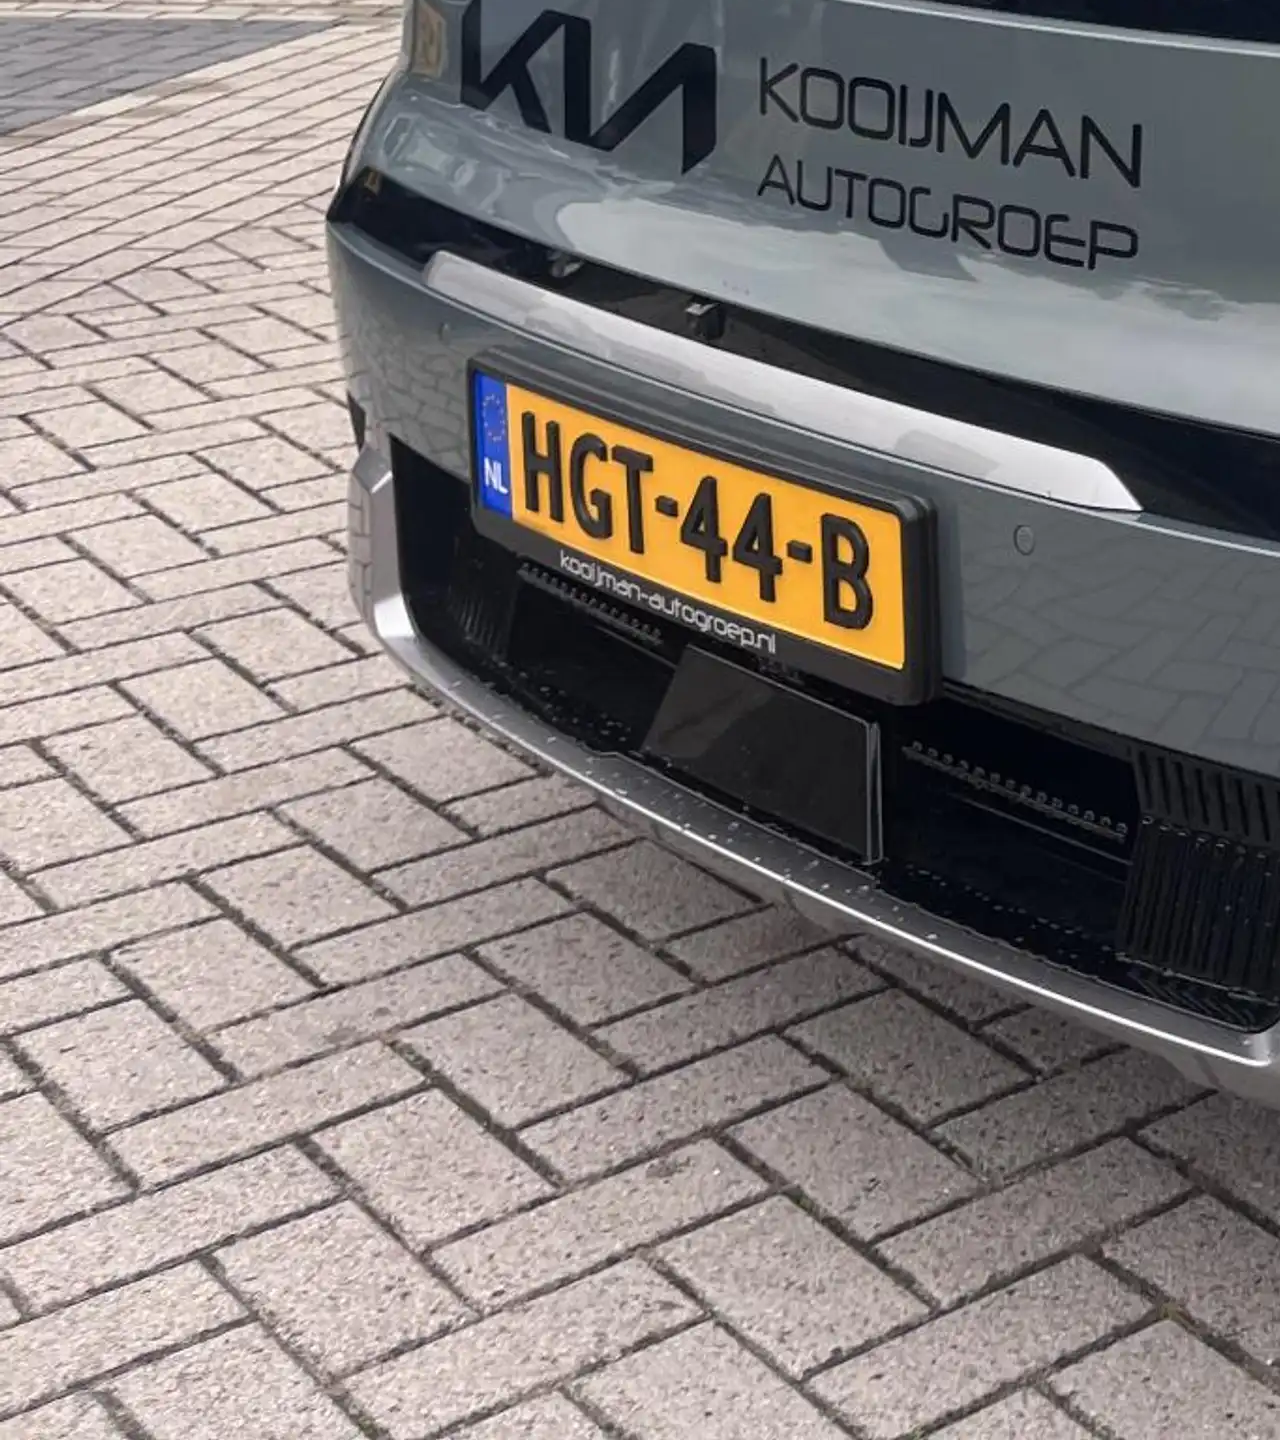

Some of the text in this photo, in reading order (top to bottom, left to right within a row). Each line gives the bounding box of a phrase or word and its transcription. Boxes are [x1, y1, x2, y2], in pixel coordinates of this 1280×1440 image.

[758, 56, 1144, 188] KOOIJMAN
[757, 153, 1139, 271] AUTOGROEP
[483, 457, 509, 495] NL
[521, 410, 874, 631] HGT-44-B
[559, 549, 776, 655] kooijman-autogroep.nl
